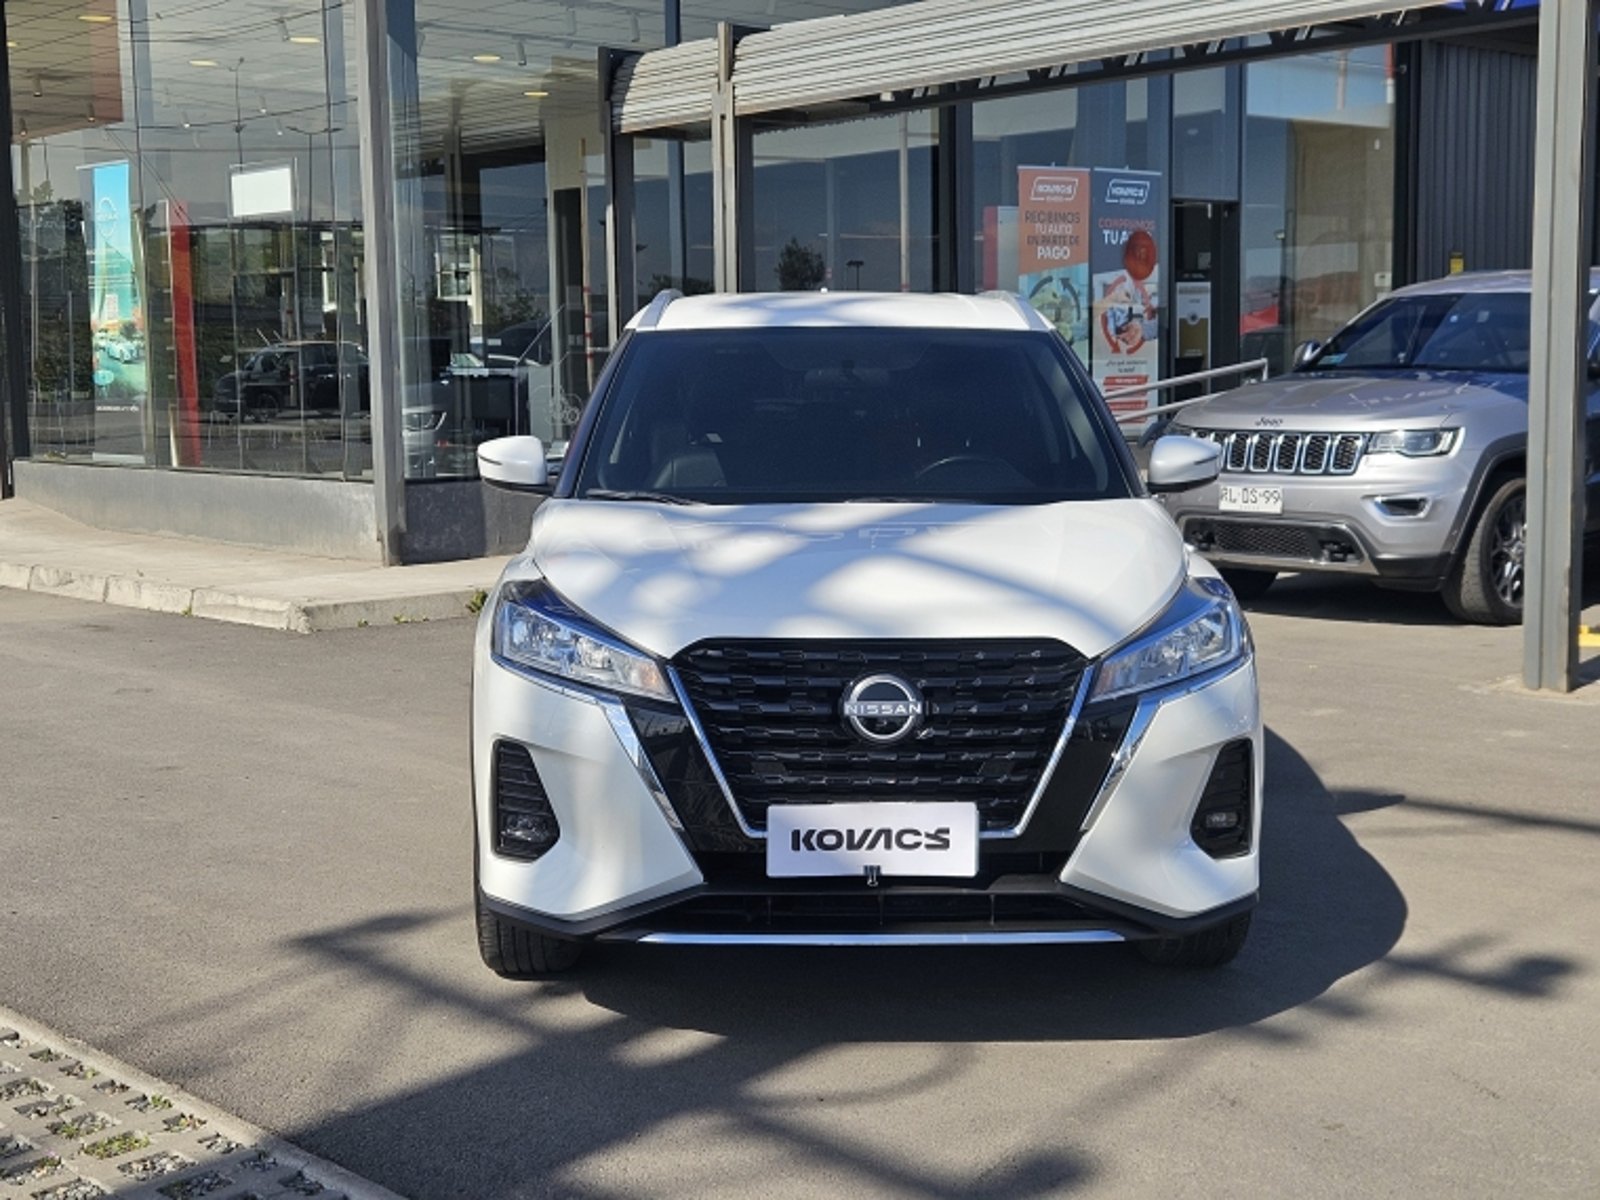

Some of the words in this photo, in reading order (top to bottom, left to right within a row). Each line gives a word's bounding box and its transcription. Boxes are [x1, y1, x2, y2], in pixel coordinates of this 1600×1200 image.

[1025, 210, 1081, 224] RECIBIMOS
[1102, 229, 1119, 244] TU
[1036, 245, 1071, 260] PAGO
[844, 702, 922, 715] NISSAN
[790, 827, 951, 852] KOVACS
